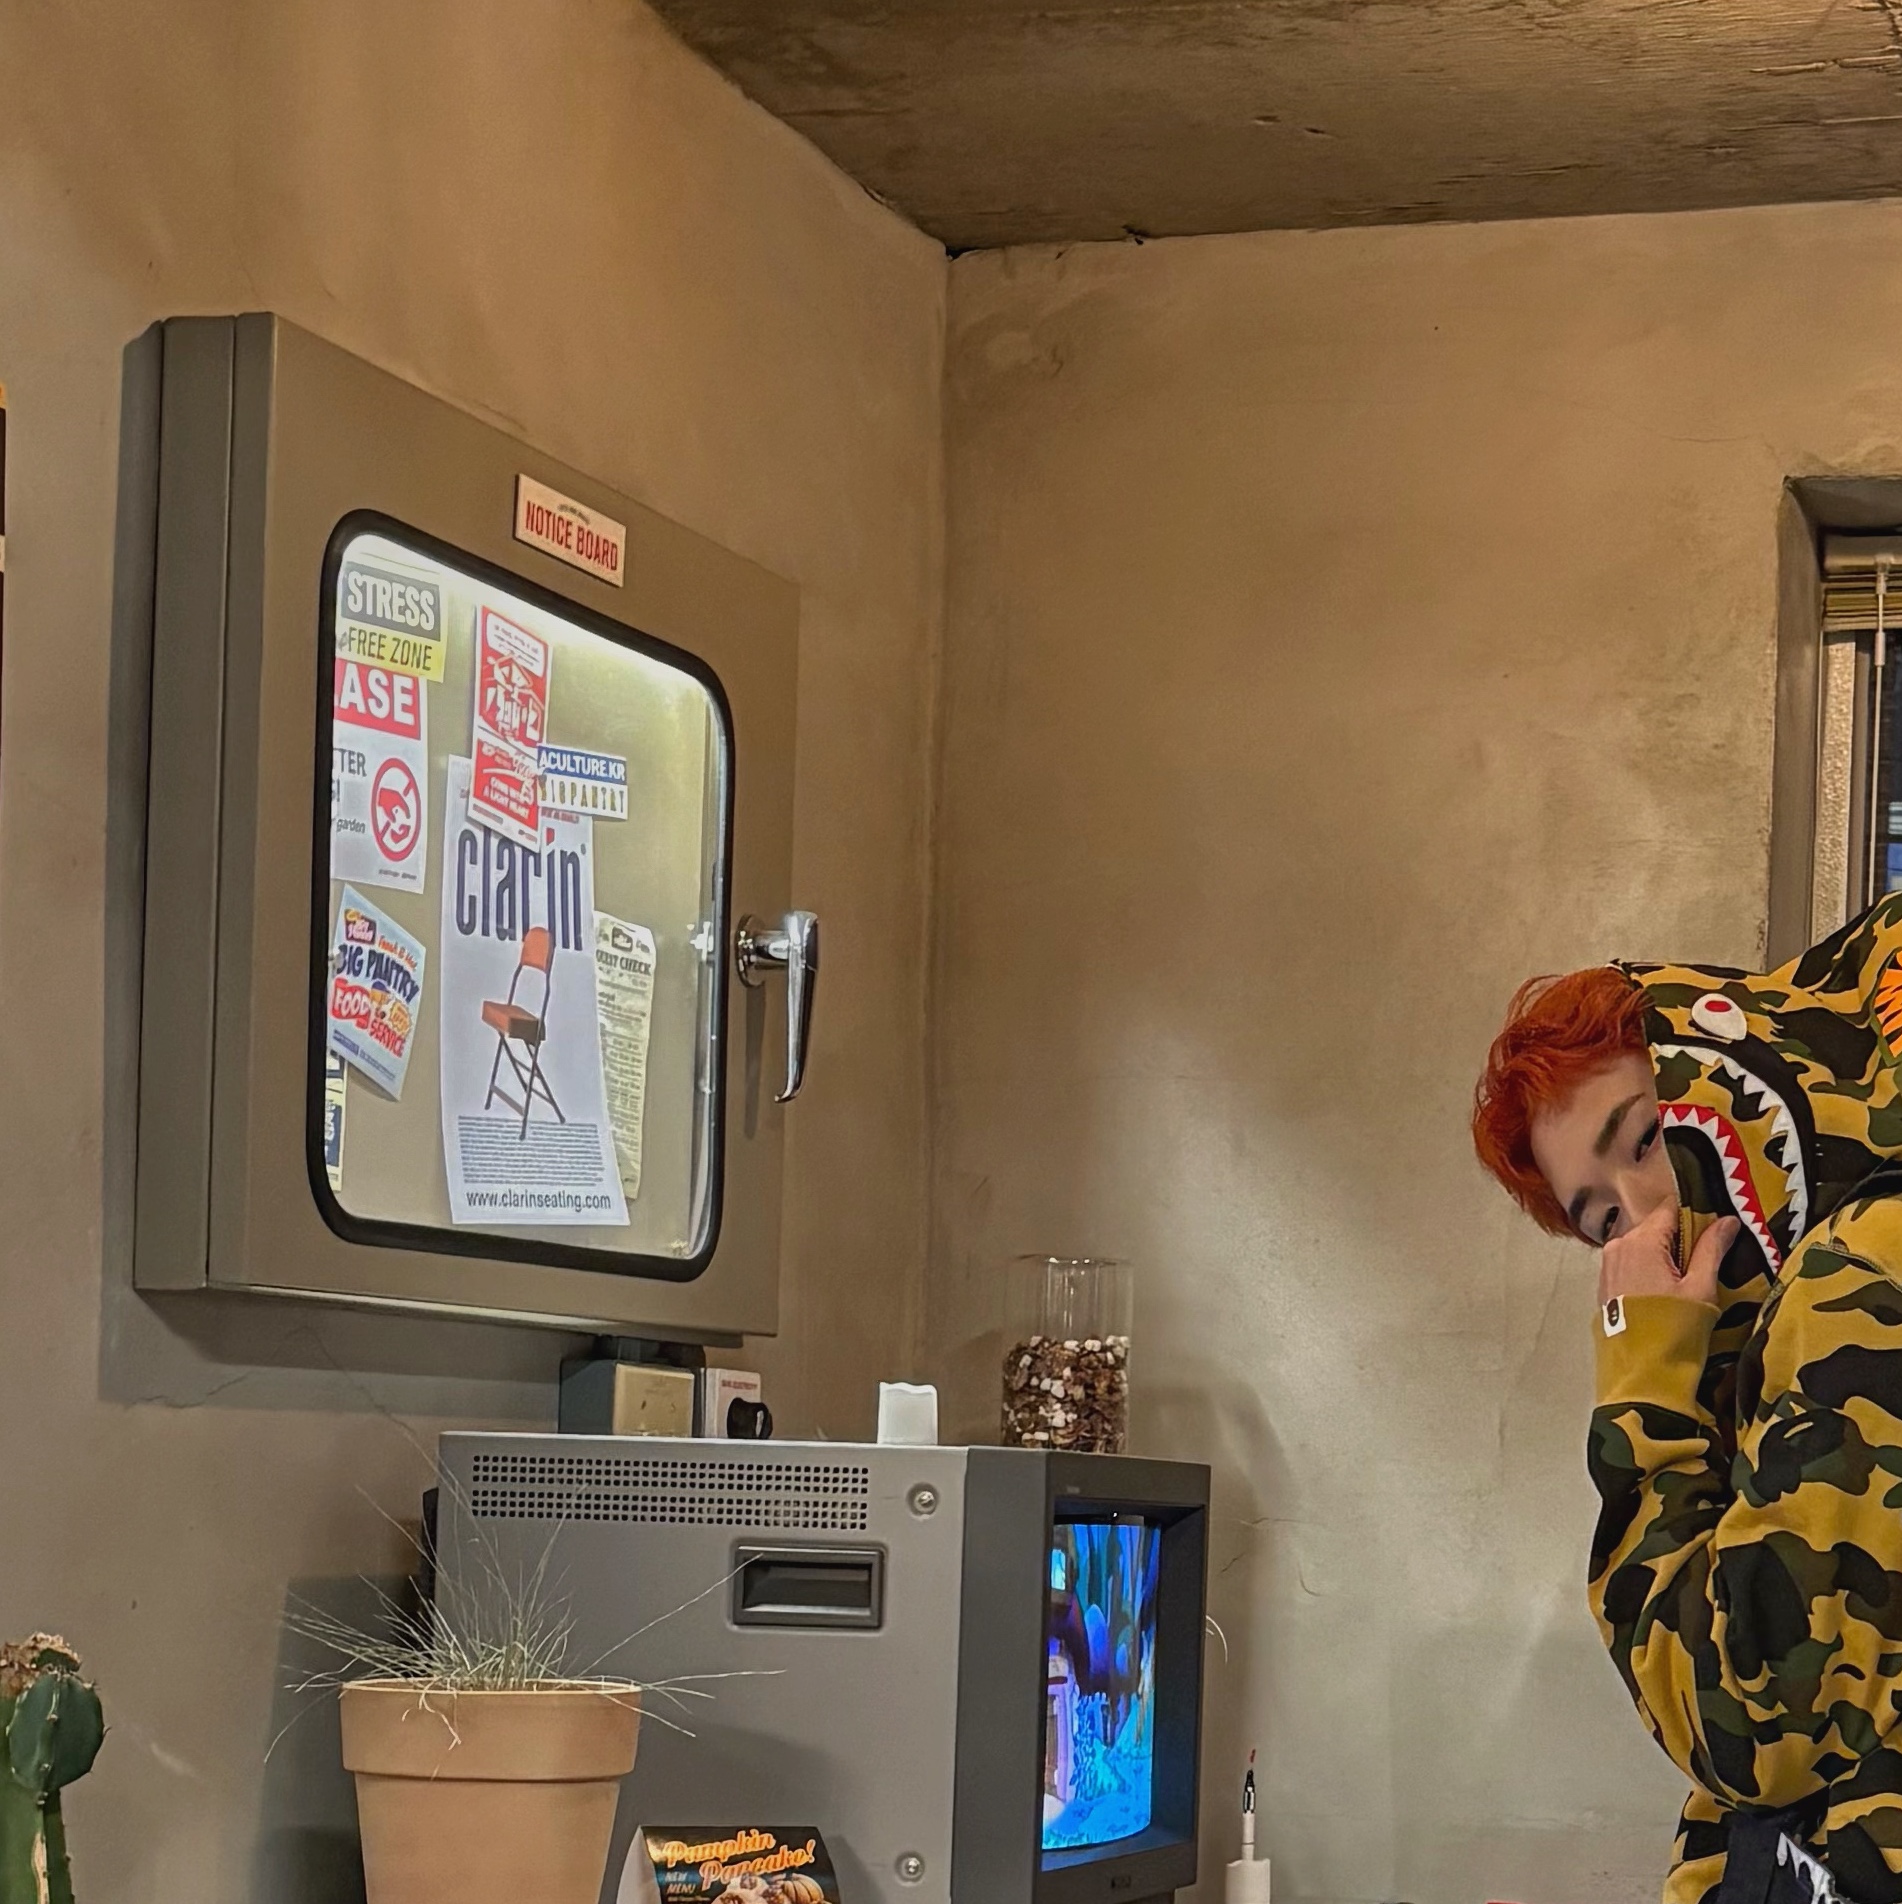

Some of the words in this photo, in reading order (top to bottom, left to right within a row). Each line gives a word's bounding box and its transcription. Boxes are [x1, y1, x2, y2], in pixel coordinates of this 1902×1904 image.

[525, 500, 573, 550] NOTICE
[576, 525, 618, 571] BOARD
[347, 571, 435, 631] STRESS
[348, 626, 387, 661] FREE
[389, 637, 433, 671] ZONE
[334, 661, 415, 726] ASE
[456, 827, 583, 952] clarin
[366, 949, 420, 1005] PANTRY
[620, 956, 652, 977] CHECK
[334, 988, 371, 1017] FOOD
[370, 1019, 406, 1059] SERVICE
[466, 1188, 612, 1213] www.clarinseating.com
[663, 1829, 776, 1868] Pumpkin
[665, 1871, 688, 1882] NEW
[666, 1883, 697, 1894] MENU
